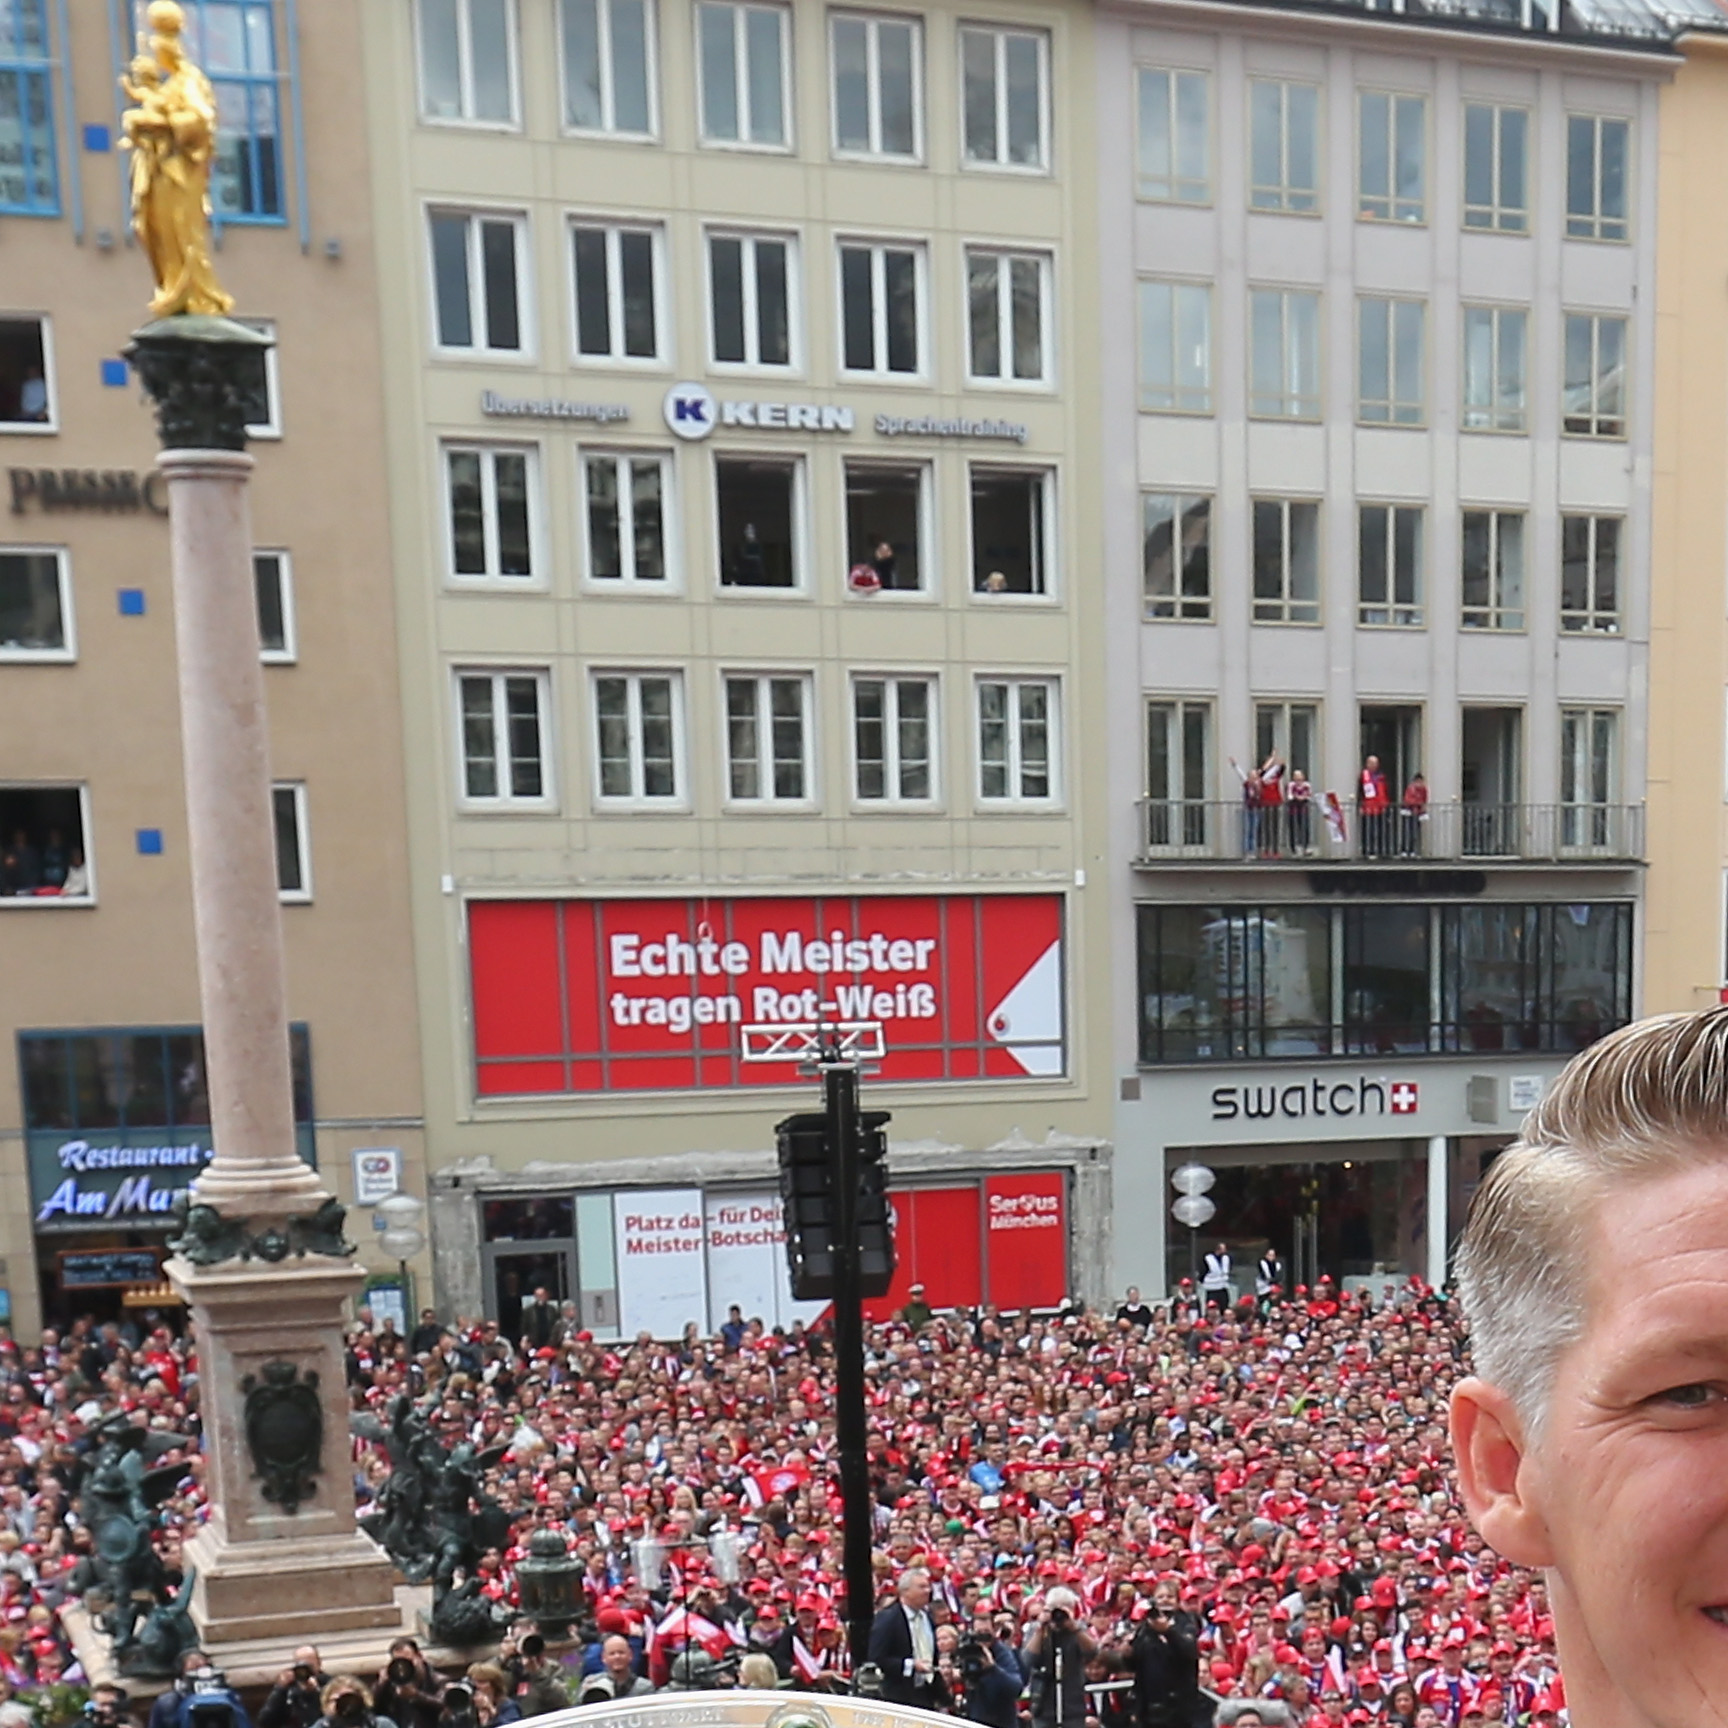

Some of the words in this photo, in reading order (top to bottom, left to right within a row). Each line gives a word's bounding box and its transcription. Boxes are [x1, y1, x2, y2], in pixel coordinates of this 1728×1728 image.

[673, 399, 708, 422] K
[721, 399, 854, 432] KERN
[874, 412, 1029, 444] Sprachentraining
[9, 467, 170, 519] PRESSEC
[610, 932, 751, 977] Echte
[759, 930, 936, 974] Meister
[610, 992, 743, 1034] tragen
[752, 983, 937, 1022] Rot-Weiß
[1212, 1076, 1385, 1120] swatch
[57, 1139, 200, 1172] Restaurant
[35, 1177, 107, 1222] Am
[625, 1213, 674, 1232] Platz
[677, 1213, 701, 1231] da
[718, 1206, 748, 1226] für
[990, 1212, 1058, 1231] München
